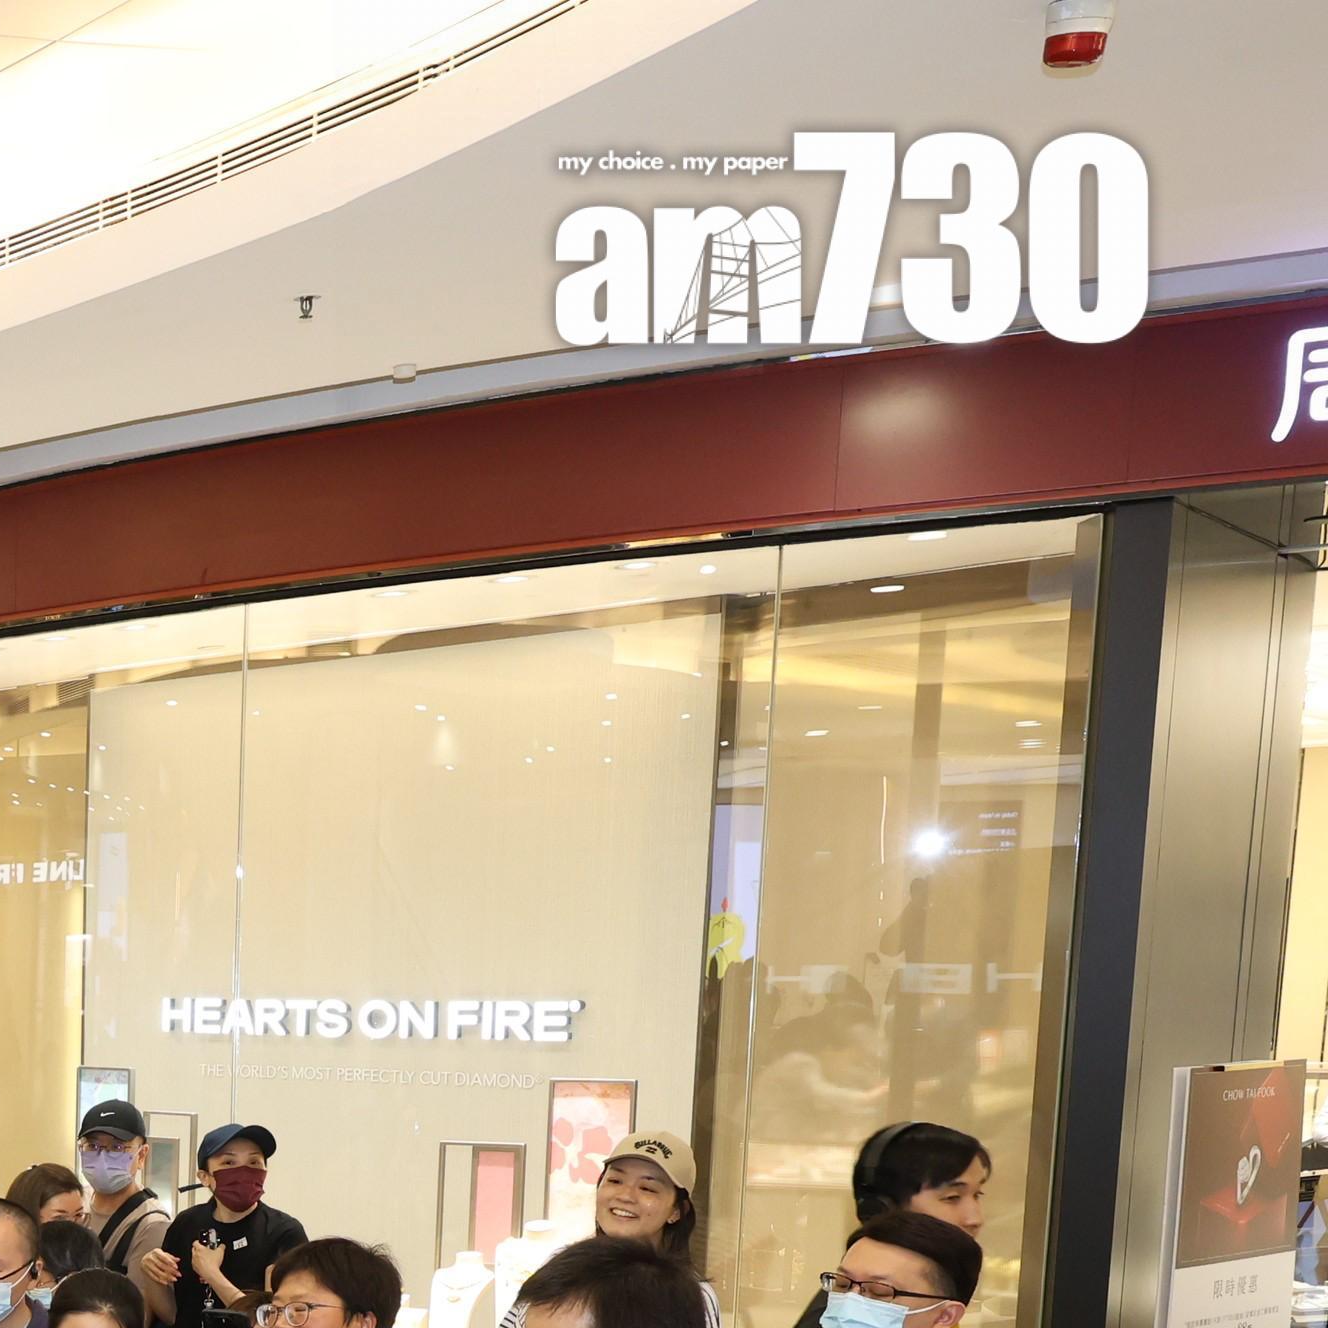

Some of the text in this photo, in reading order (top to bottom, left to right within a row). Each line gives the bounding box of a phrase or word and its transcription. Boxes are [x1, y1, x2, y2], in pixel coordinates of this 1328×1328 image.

[161, 996, 346, 1039] HEARTS
[358, 999, 434, 1040] ON
[199, 1063, 224, 1077] THE
[292, 1066, 333, 1081] MOST
[337, 1067, 415, 1085] PERFECTLY
[420, 1070, 451, 1086] CUT
[1223, 1089, 1244, 1101] CHOW
[1213, 1274, 1258, 1300] 限時優惠
